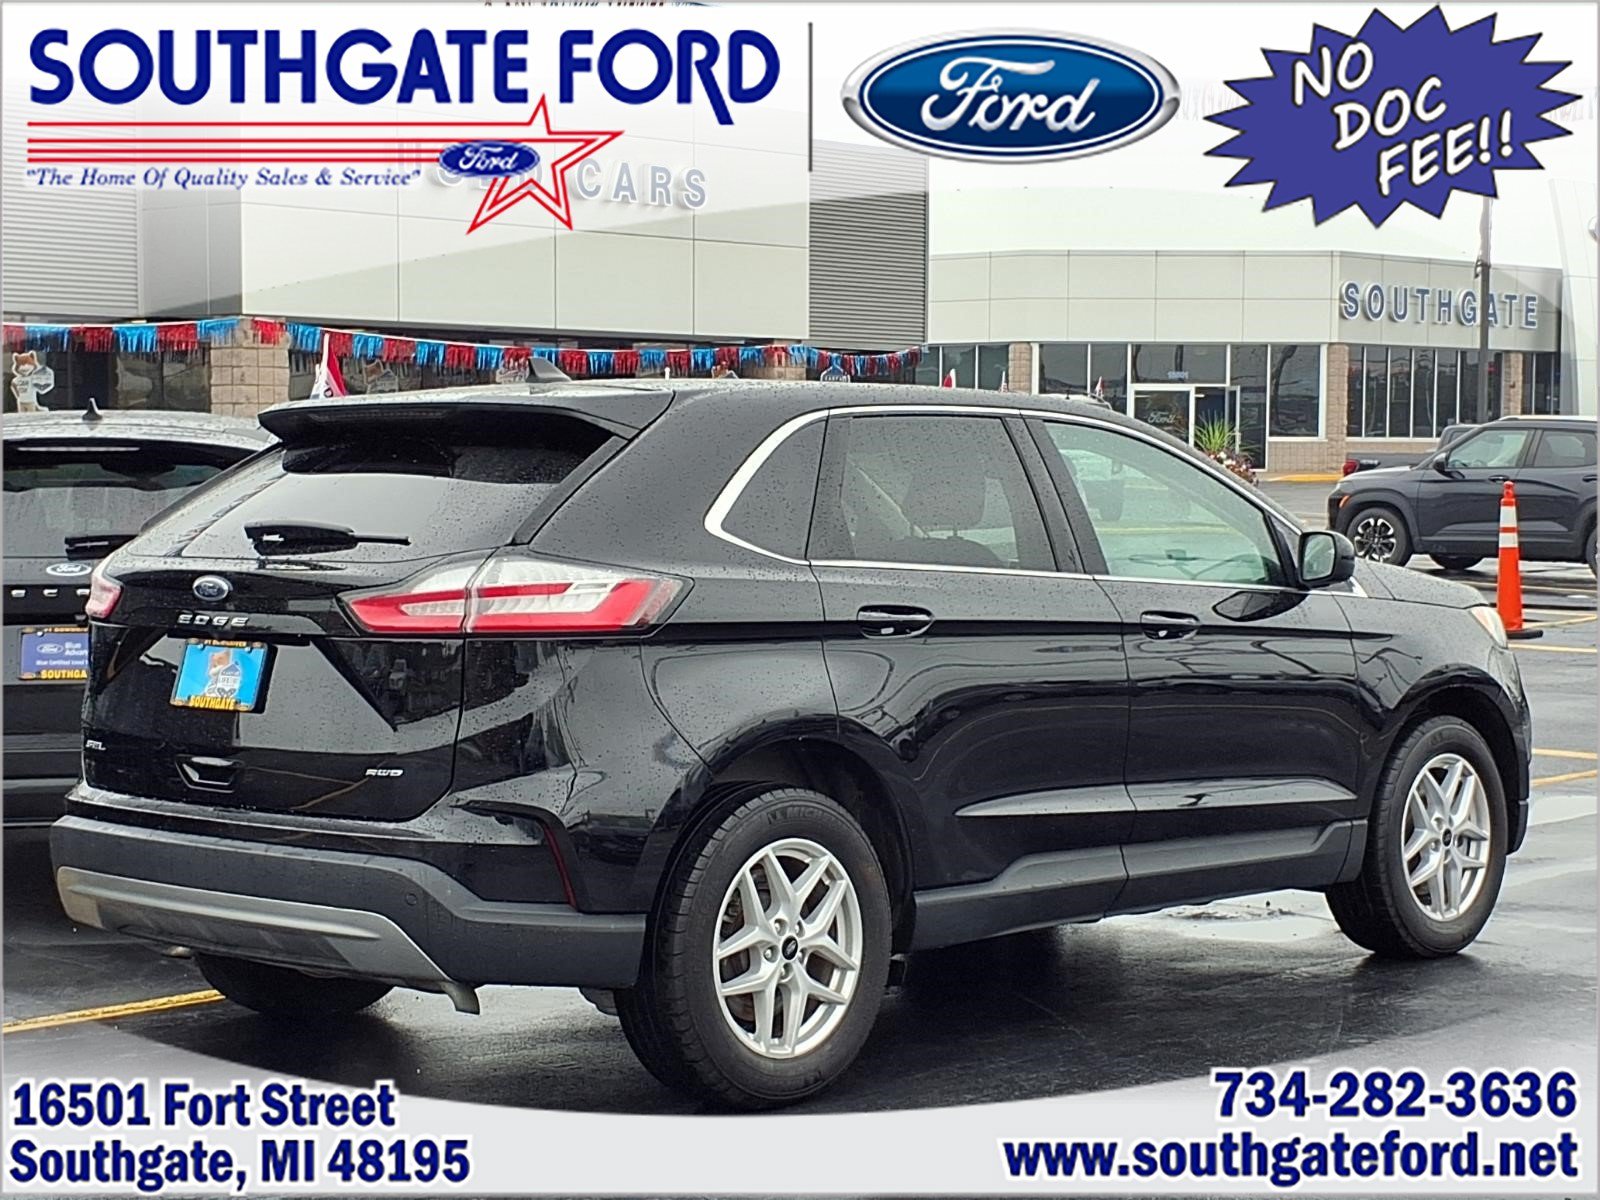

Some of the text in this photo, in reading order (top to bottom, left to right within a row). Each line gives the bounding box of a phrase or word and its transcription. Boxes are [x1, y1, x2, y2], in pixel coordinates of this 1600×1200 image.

[575, 158, 706, 208] CARS
[1341, 281, 1537, 328] SOUTHGATE
[178, 614, 249, 627] EDGE
[40, 669, 87, 679] SOUTHGA
[189, 694, 236, 711] SOUTHGATE
